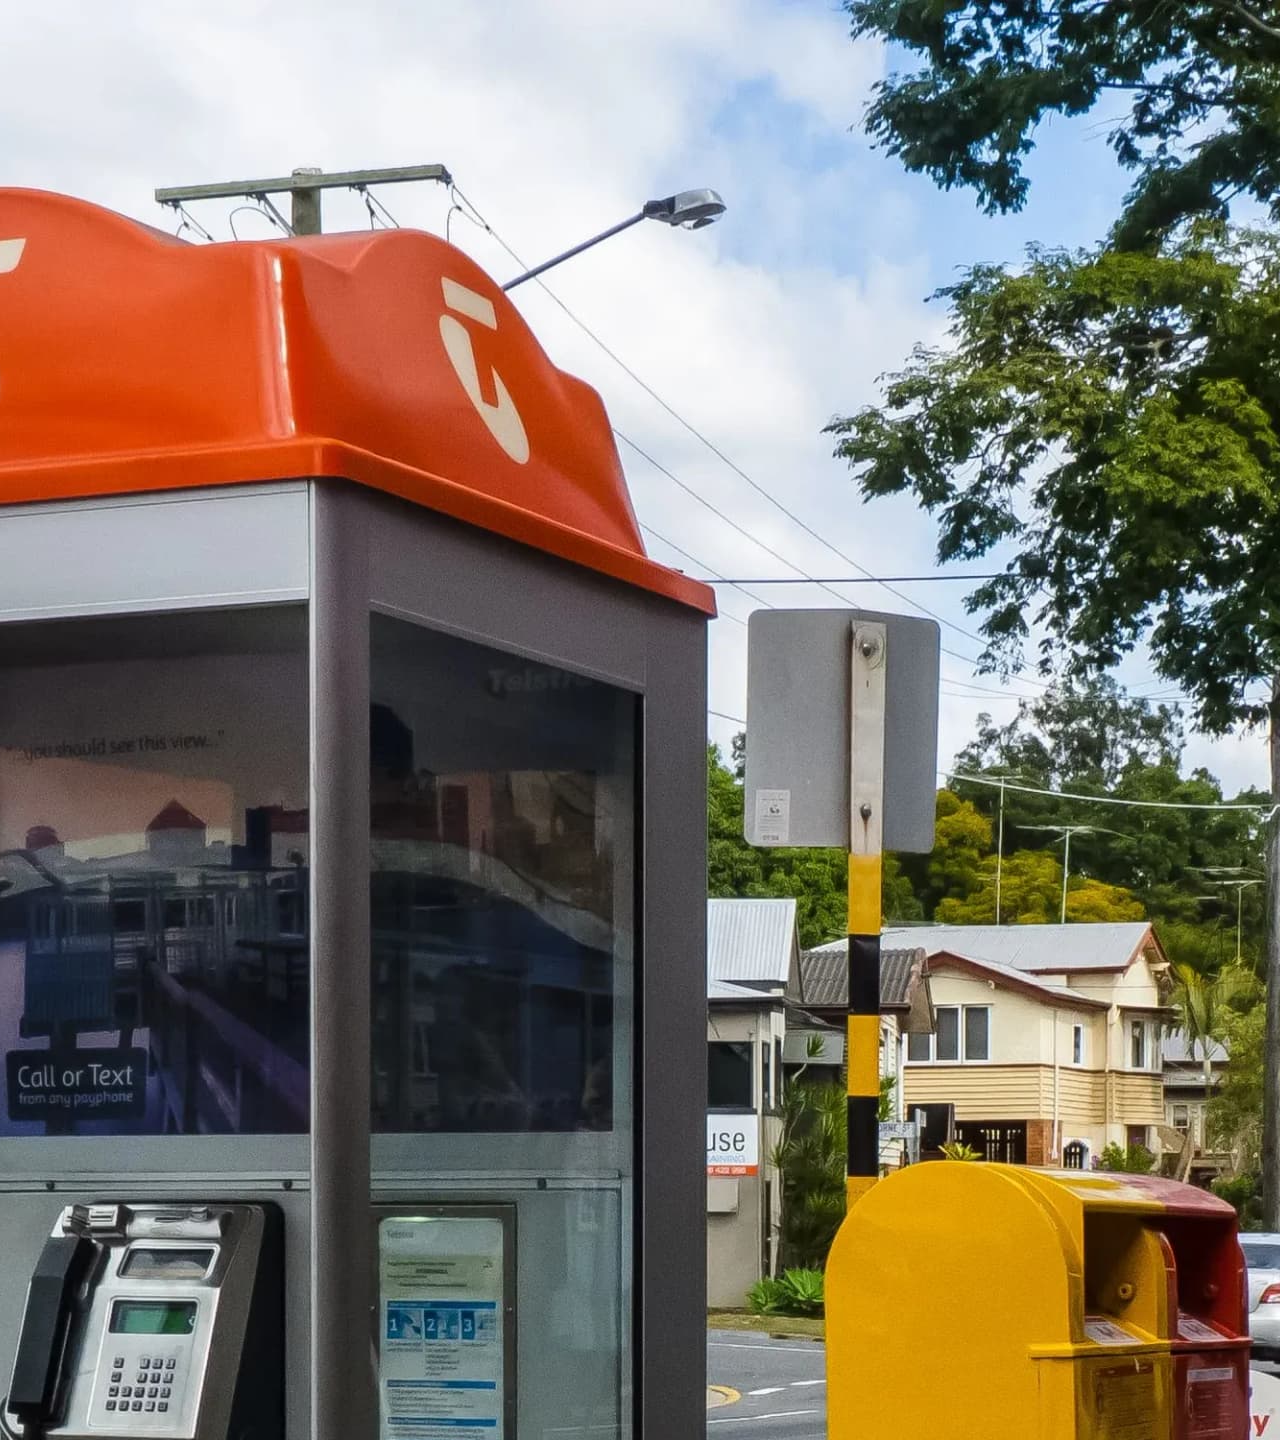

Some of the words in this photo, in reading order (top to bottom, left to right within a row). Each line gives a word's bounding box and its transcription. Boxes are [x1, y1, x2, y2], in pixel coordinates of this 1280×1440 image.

[55, 737, 107, 758] should
[109, 740, 135, 755] see
[138, 735, 167, 752] this
[18, 1064, 56, 1088] Call
[62, 1070, 84, 1087] or
[87, 1064, 134, 1086] Text
[19, 1092, 47, 1105] from
[48, 1094, 71, 1108] any
[73, 1091, 134, 1109] payphone
[389, 1319, 398, 1332] 1
[426, 1319, 435, 1332] 2
[463, 1319, 472, 1332] 3
